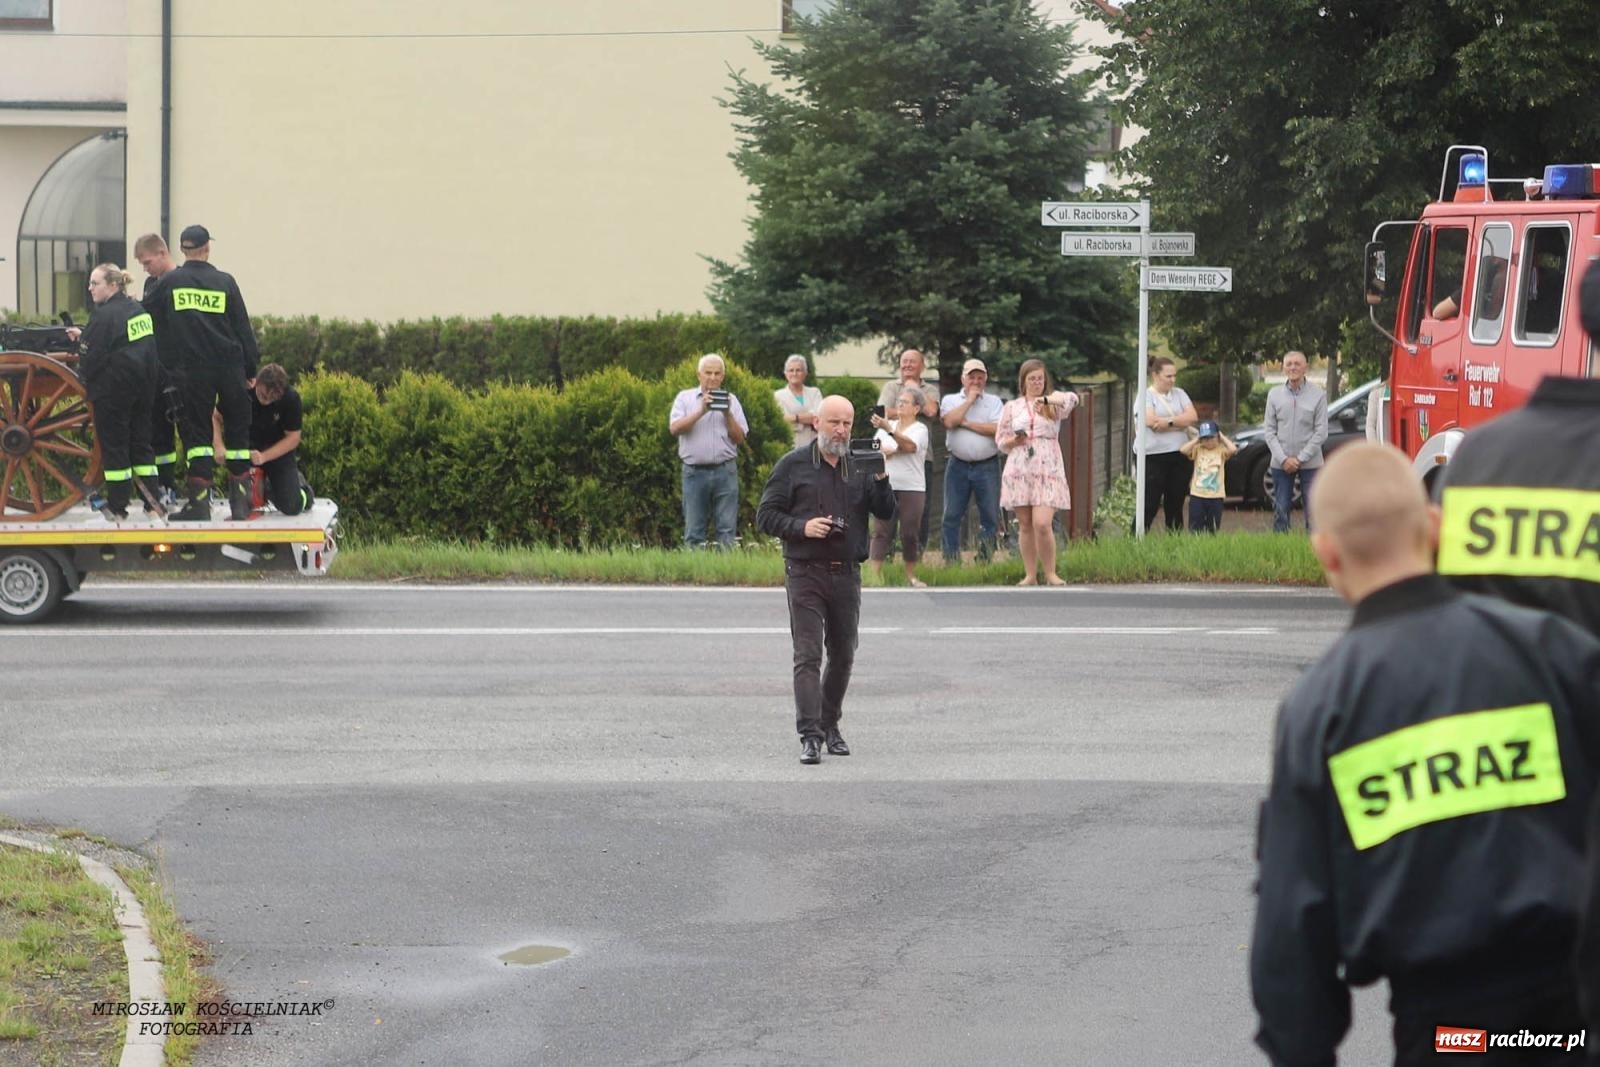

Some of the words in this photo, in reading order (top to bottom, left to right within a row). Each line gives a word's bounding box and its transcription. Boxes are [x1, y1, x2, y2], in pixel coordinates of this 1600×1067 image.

[1058, 209, 1071, 220] ul.
[1073, 208, 1128, 221] Raciborska
[1074, 239, 1085, 250] ul.
[1086, 238, 1132, 251] Raciborska
[1151, 272, 1167, 284] Dom
[1168, 272, 1197, 288] Weselny
[1198, 273, 1217, 285] REGE
[1464, 360, 1500, 383] Feuerwehr
[1469, 384, 1481, 407] Ruf
[1483, 386, 1494, 409] 112
